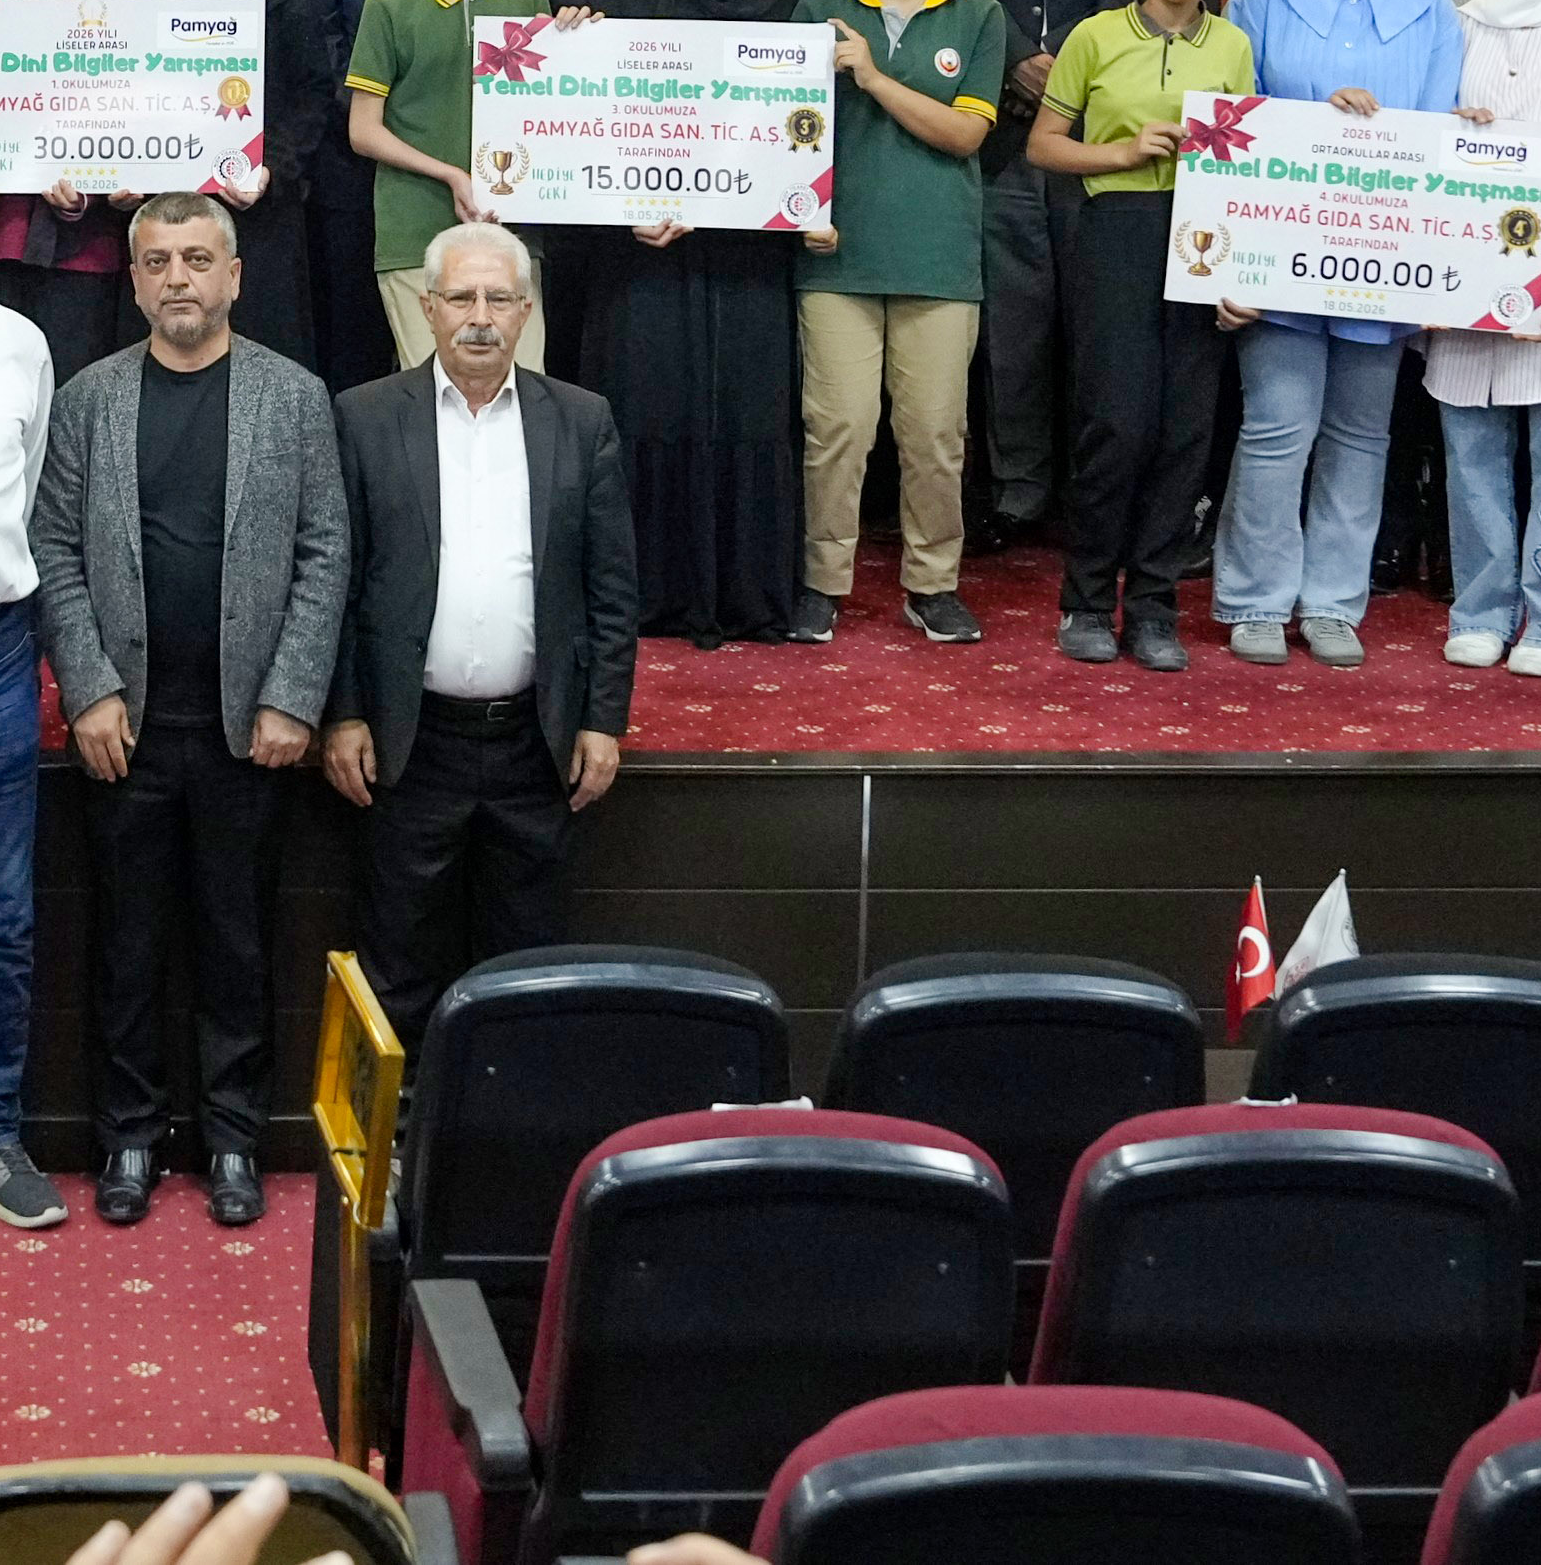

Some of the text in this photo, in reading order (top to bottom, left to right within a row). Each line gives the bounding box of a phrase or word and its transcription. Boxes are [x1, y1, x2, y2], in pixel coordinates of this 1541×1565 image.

[171, 17, 237, 35] Pamyağ
[1, 53, 47, 73] Dini
[53, 52, 140, 76] Bilgiler
[145, 52, 258, 77] Yarışması
[738, 44, 806, 64] Pamyağ
[475, 74, 827, 106] Temel Dini Bilgiler Yarışması
[50, 96, 91, 112] GIDA
[523, 118, 604, 137] PAMYAĞ
[611, 122, 653, 138] GIDA
[1456, 138, 1527, 162] Pamyağ
[1181, 152, 1260, 178] Temel
[1267, 158, 1317, 184] Dini
[1325, 163, 1418, 193] Bilgiler
[1226, 201, 1311, 225] PAMYAĞ
[1318, 209, 1363, 228] GIDA
[1292, 253, 1434, 289] 6.000.00
